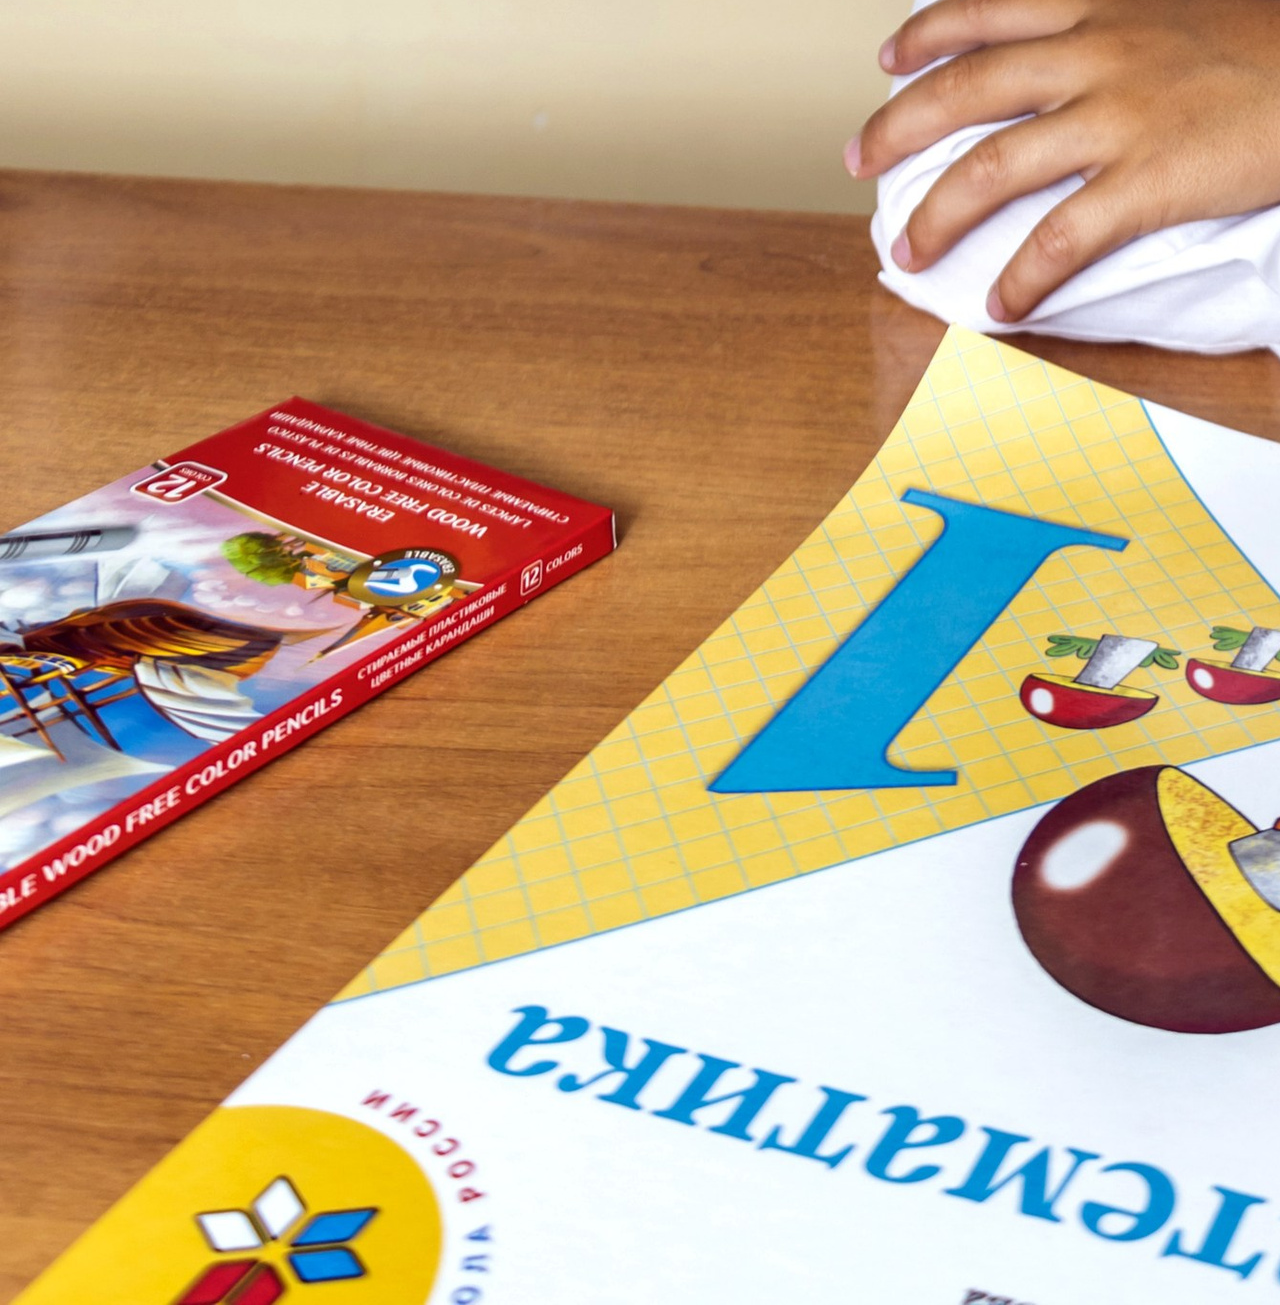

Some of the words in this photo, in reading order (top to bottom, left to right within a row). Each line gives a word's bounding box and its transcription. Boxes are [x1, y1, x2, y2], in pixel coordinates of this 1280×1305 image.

[253, 442, 327, 474] PENCILS
[323, 442, 342, 457] DE
[347, 433, 403, 465] ЦВЕТНЫЕ
[322, 466, 383, 495] COLOR
[340, 450, 409, 481] BORRABLES
[403, 455, 493, 493] ПЛАСТИКОВЫЕ
[146, 473, 198, 499] 12
[301, 480, 396, 524] ERASABLE
[380, 488, 430, 515] FREE
[406, 478, 463, 501] COLORES
[458, 495, 481, 510] DE
[490, 488, 570, 524] СТИРАЕМЫЕ
[426, 505, 489, 539] WOOD
[404, 550, 456, 575] ERASABLE
[522, 565, 540, 589] 12
[545, 543, 584, 573] COLORS
[357, 631, 428, 680] СТИРАЕМЫЕ
[428, 582, 507, 637] ПЛАСТИКОВЫЕ
[370, 648, 424, 689] ЦВЕТНЫЕ
[425, 605, 495, 655] КАРАНДАШИ
[41, 822, 122, 882] WOOD
[125, 785, 181, 833] FREE
[185, 740, 258, 795] COLOR
[261, 687, 344, 750] PENCILS
[361, 1089, 487, 1204] РОССИИ
